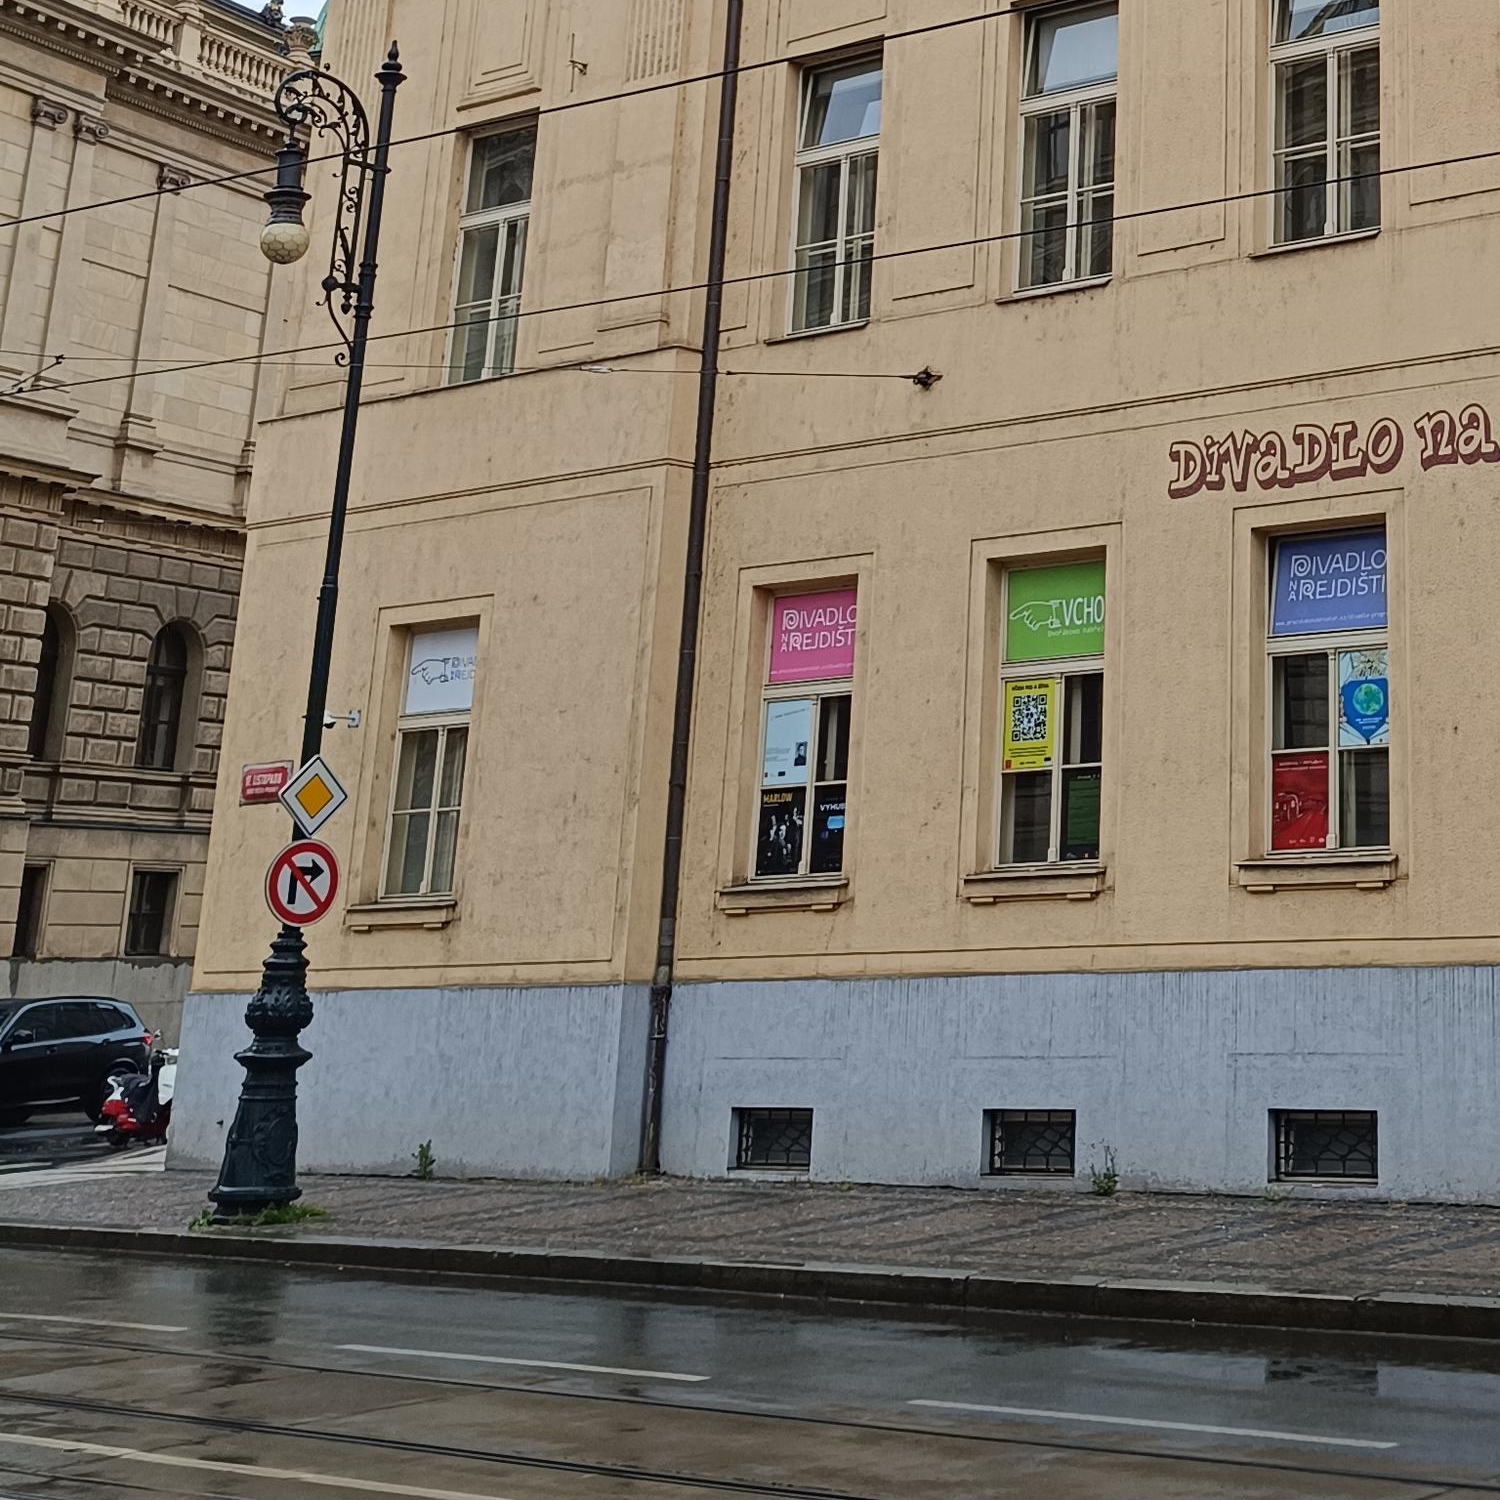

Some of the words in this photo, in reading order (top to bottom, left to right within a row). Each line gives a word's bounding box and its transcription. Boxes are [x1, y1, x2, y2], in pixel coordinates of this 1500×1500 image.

[1414, 403, 1500, 471] na
[1290, 549, 1387, 578] DIVADLO
[1299, 571, 1386, 601] REJDIŠTI
[782, 605, 857, 631] DIVADLO
